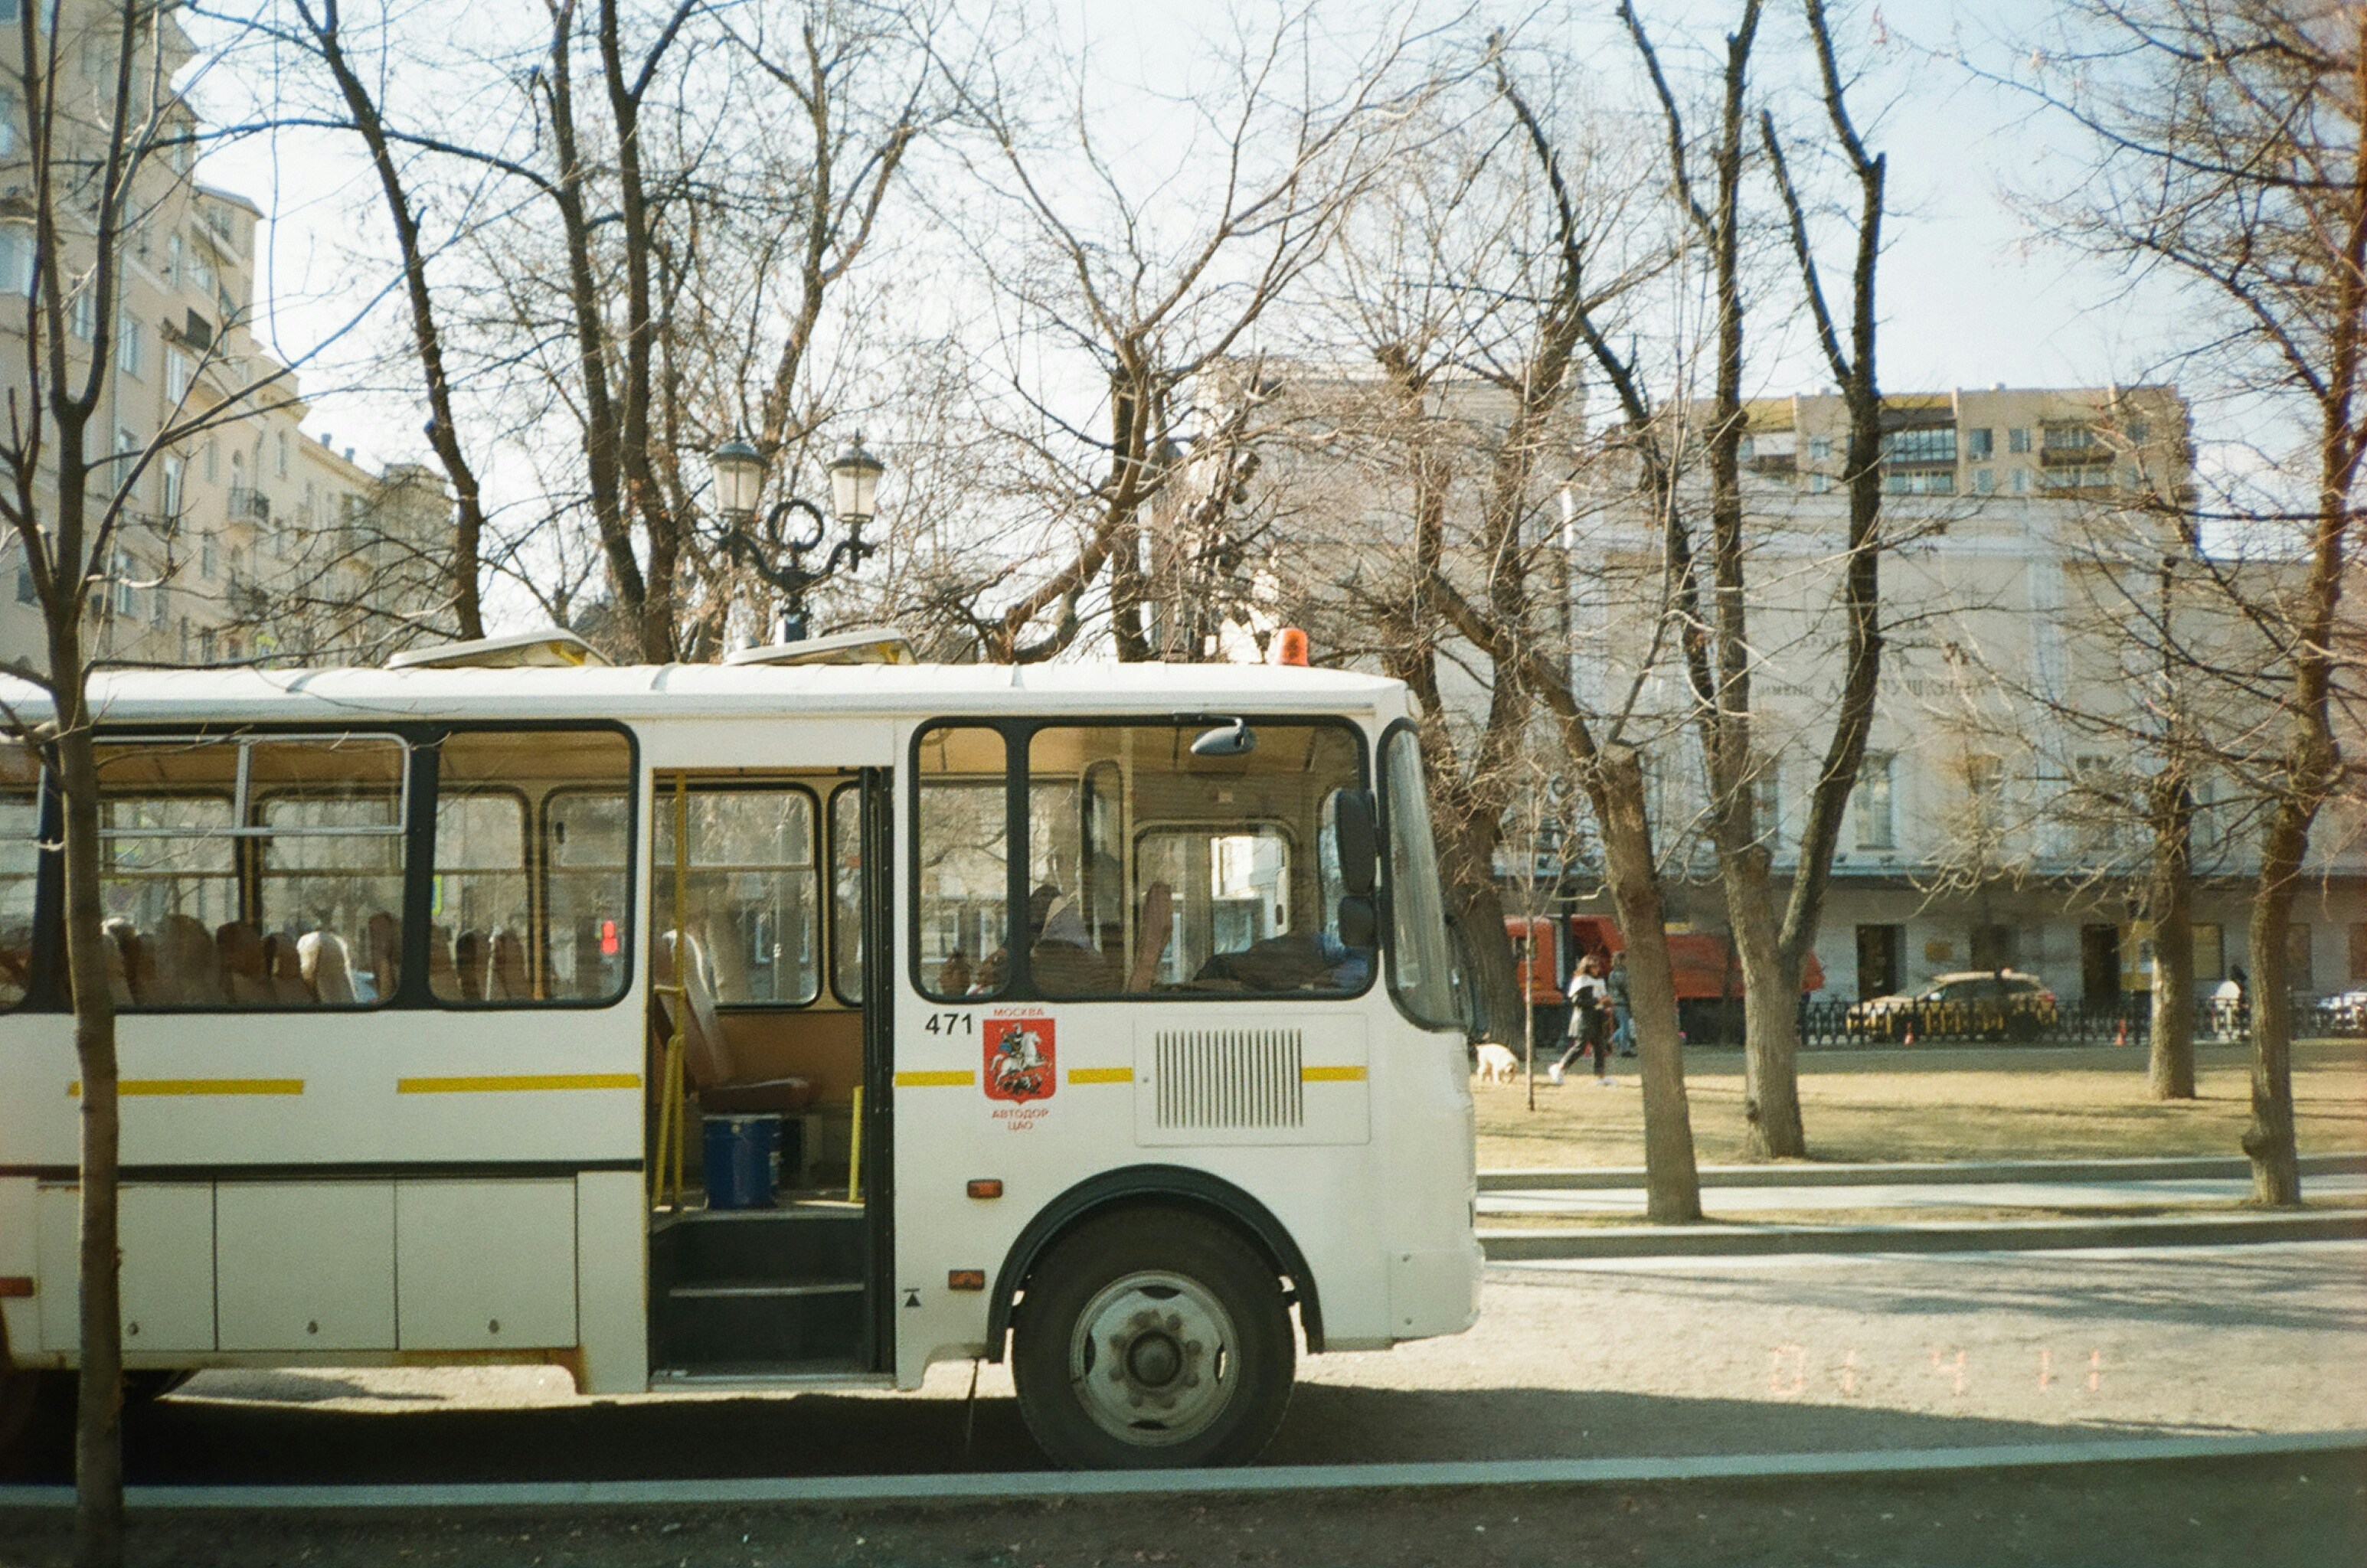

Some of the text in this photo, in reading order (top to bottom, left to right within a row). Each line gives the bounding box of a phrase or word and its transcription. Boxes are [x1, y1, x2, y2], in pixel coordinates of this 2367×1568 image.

[993, 1007, 1045, 1017] МОСКВА
[924, 1013, 973, 1034] 471
[992, 1109, 1049, 1119] АВТОДОР
[1007, 1121, 1034, 1132] ЦАО
